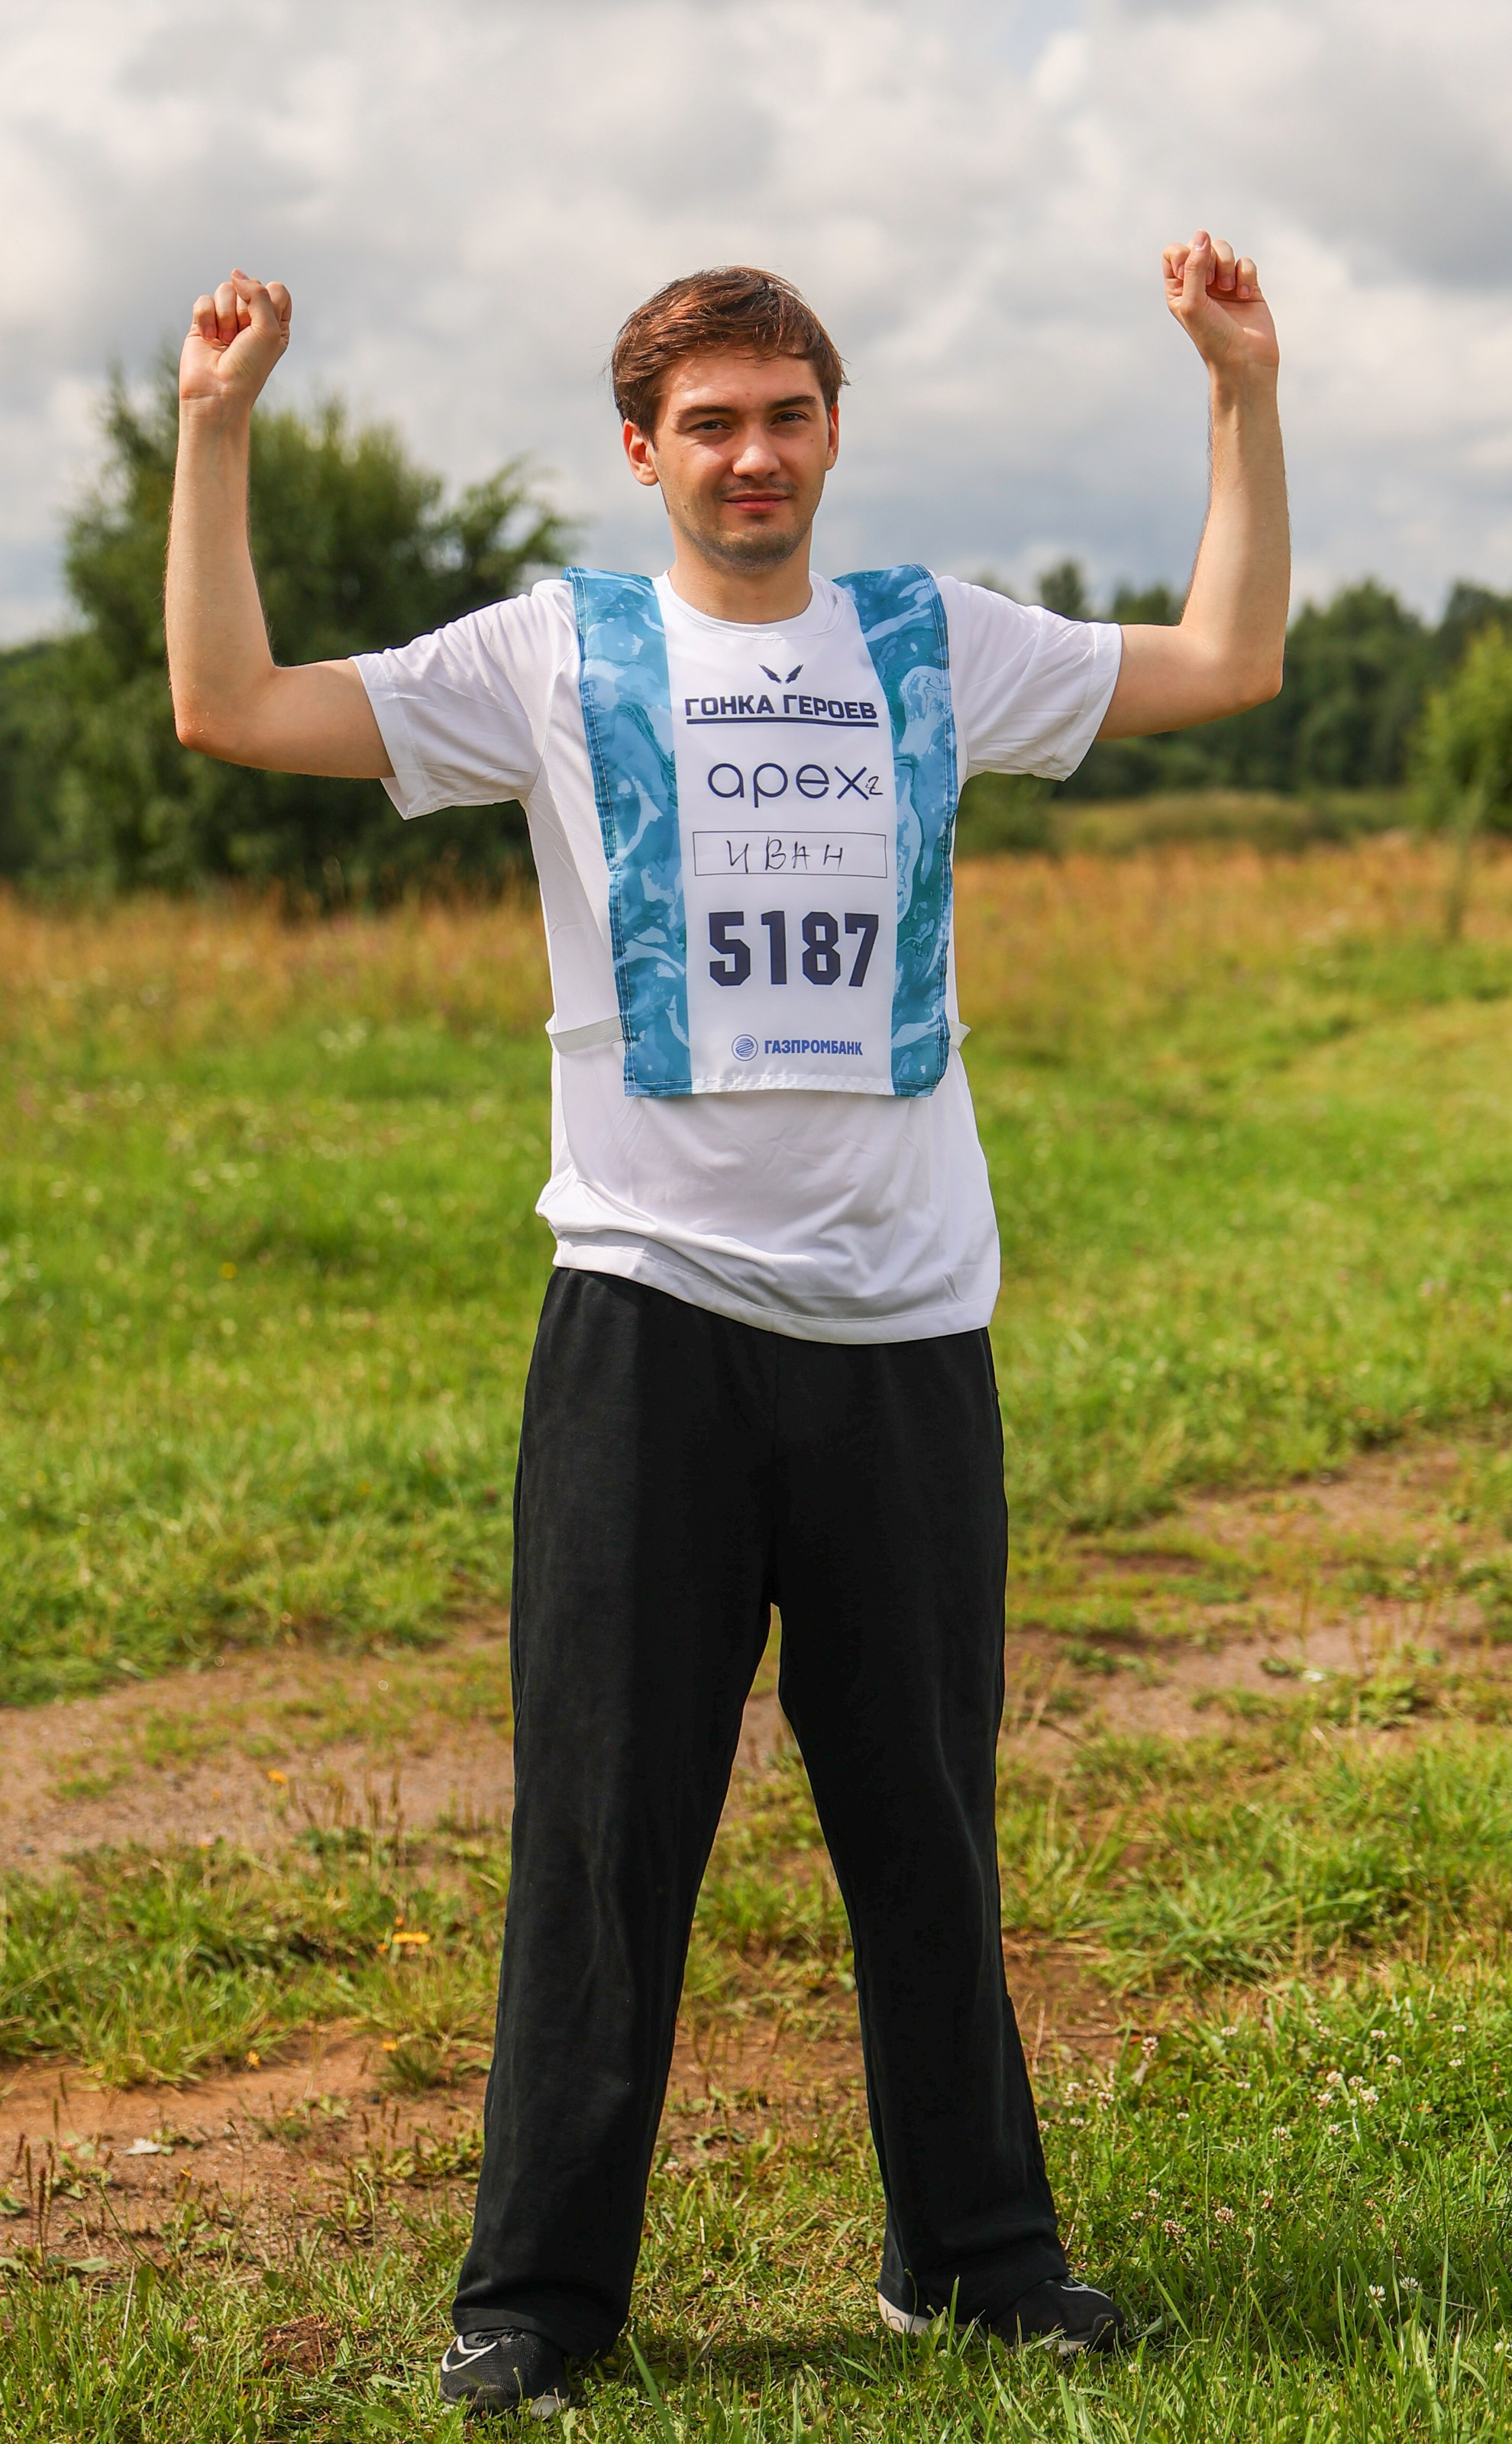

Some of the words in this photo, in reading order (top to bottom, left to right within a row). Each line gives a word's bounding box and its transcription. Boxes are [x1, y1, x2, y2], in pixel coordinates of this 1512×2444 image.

[684, 694, 775, 716] ГОНКА
[783, 694, 878, 719] ГЕРОЕВ
[707, 761, 870, 809] apex
[725, 836, 843, 876] ИВАН
[708, 910, 880, 988] 5187
[764, 1039, 864, 1056] ГАЗПРОМБАНК
